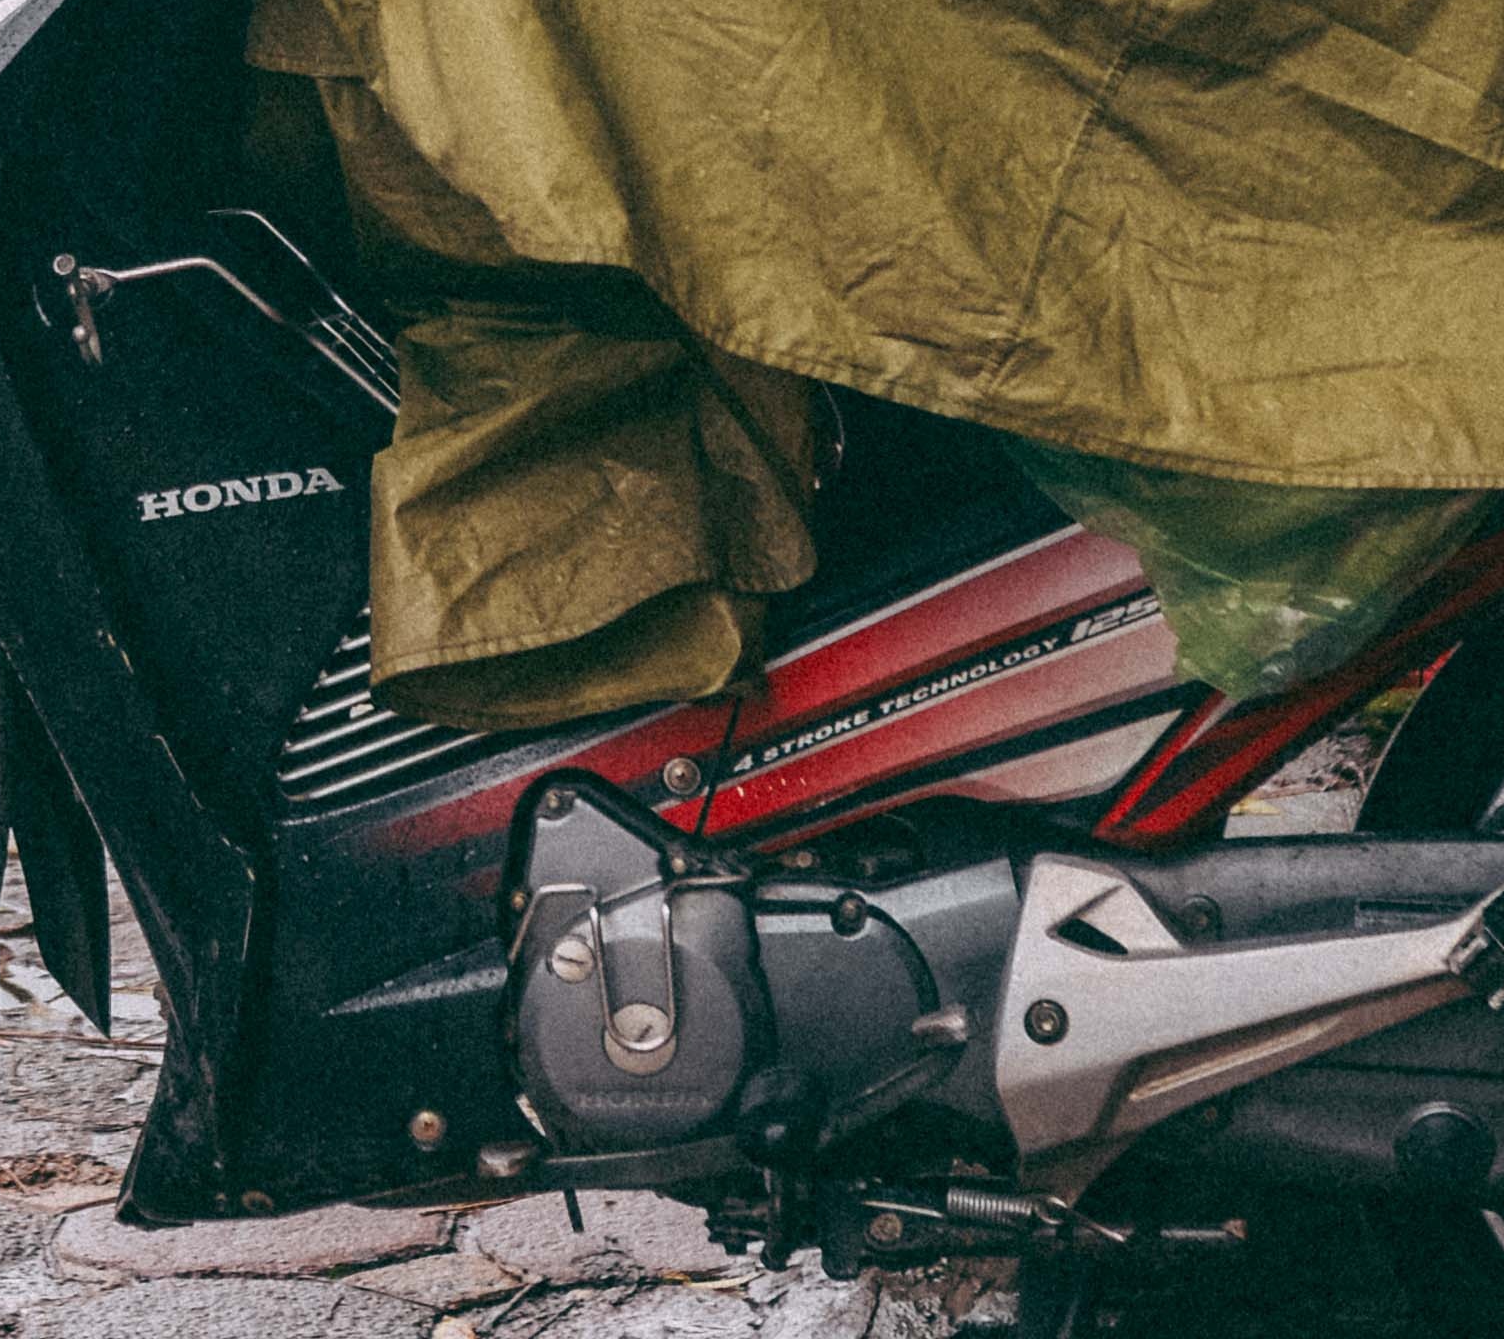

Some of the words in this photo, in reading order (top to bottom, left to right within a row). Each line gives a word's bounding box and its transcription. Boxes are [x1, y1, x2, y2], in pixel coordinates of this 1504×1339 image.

[136, 466, 345, 522] HONDA
[733, 753, 755, 773] 4
[762, 709, 870, 763] STROKE
[878, 636, 1060, 715] TECHNOLOGY
[1070, 594, 1160, 644] 125
